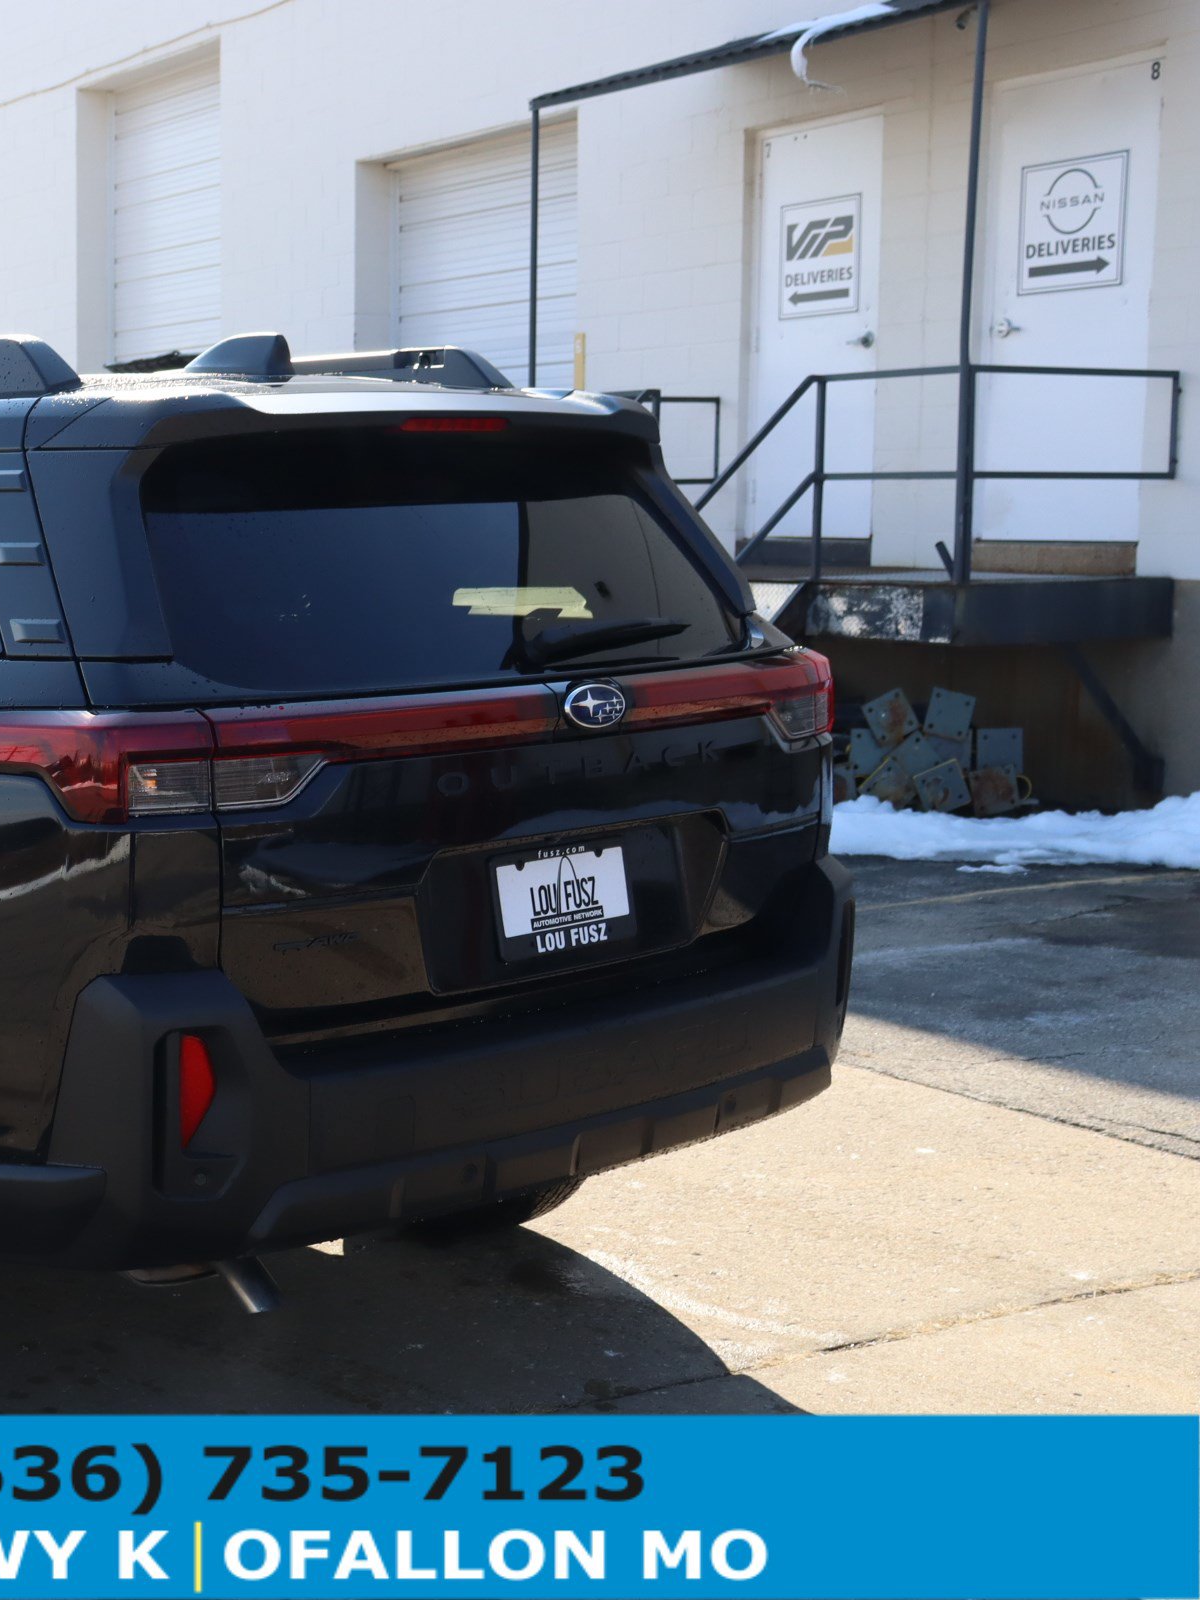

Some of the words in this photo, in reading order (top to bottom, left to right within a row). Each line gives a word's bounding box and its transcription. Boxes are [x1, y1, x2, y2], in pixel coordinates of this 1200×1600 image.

[1151, 62, 1161, 80] 8
[1040, 193, 1104, 211] NISSAN
[786, 215, 853, 261] VIP
[1026, 233, 1116, 259] DELIVERIES
[785, 266, 853, 287] DELIVERIES
[435, 739, 720, 798] OUTBACK
[537, 845, 585, 858] fusz.com
[530, 883, 557, 917] LOU
[563, 876, 599, 910] FUSZ
[533, 915, 572, 928] AUTOMOTIVE
[574, 909, 603, 921] NETWORK
[536, 931, 566, 953] LOU
[570, 923, 607, 946] FUSZ
